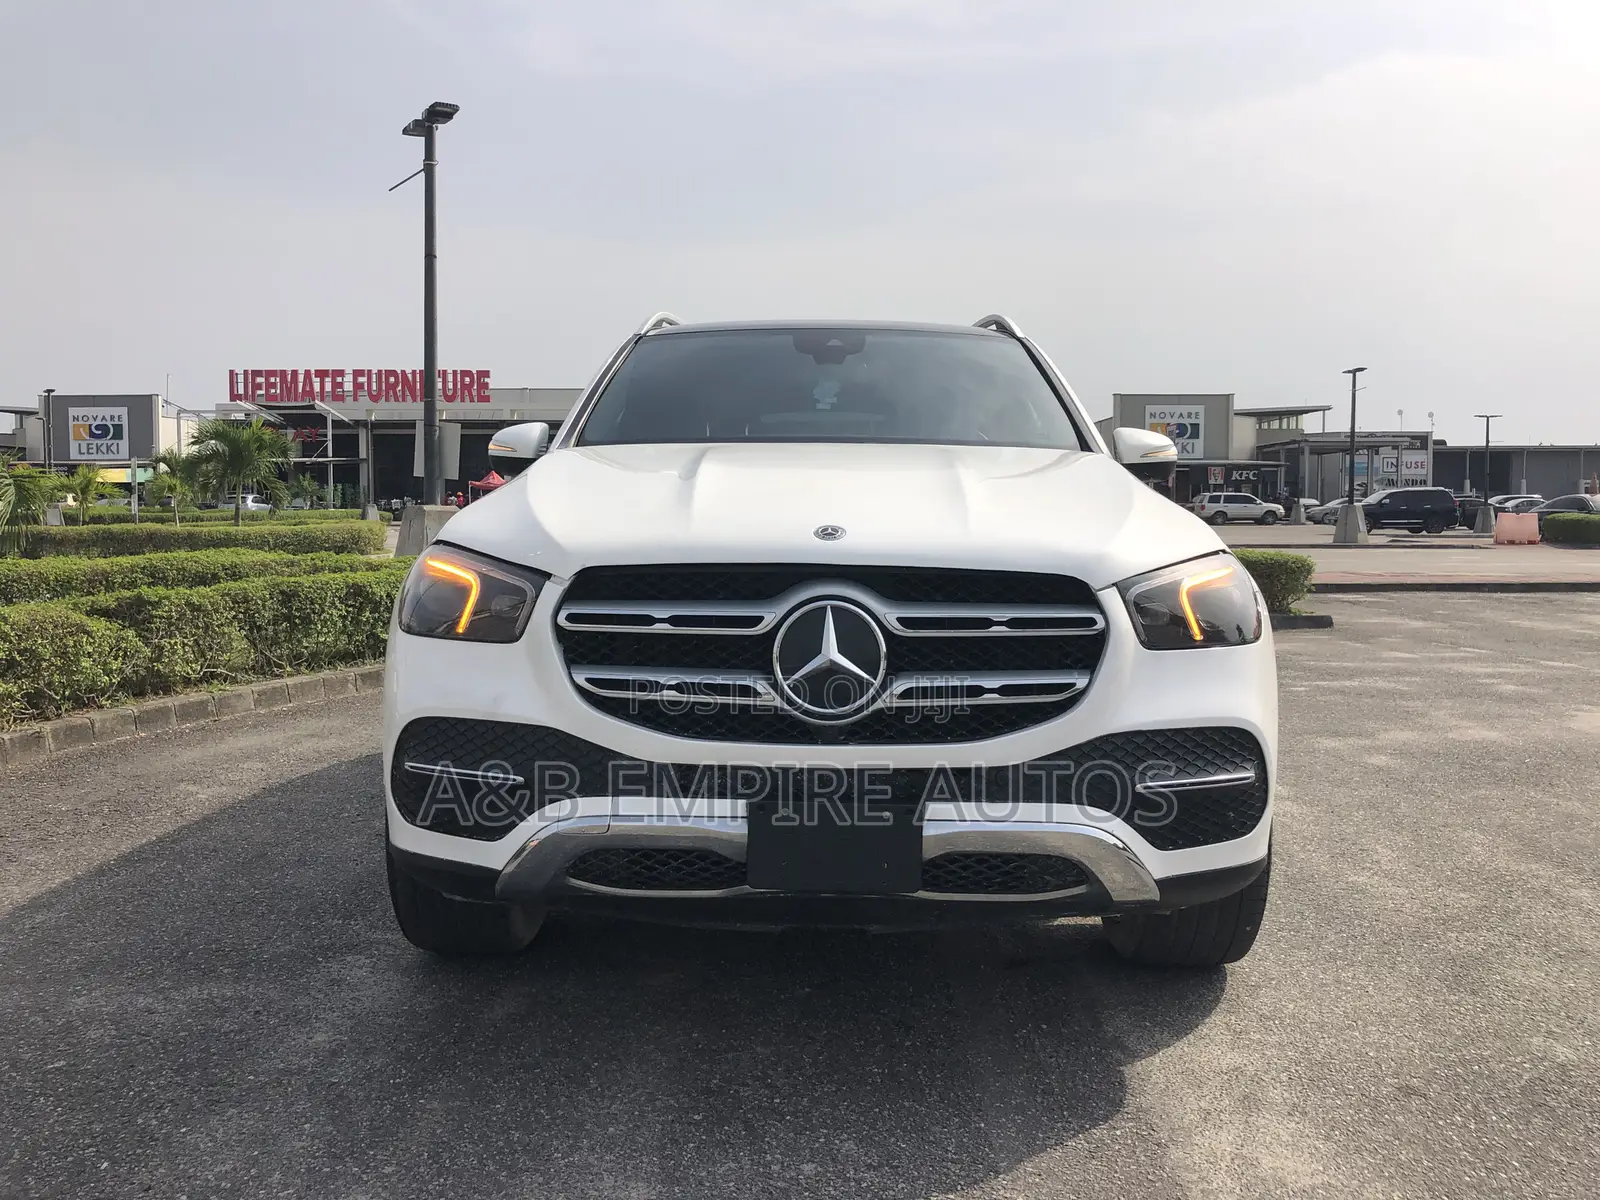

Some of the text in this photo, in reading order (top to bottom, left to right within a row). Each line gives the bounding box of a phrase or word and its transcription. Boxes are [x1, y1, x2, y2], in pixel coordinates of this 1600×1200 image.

[229, 369, 490, 402] LIFEMATE FURNIURE
[72, 414, 123, 422] NOVARE
[1149, 411, 1200, 420] NOVARE
[78, 442, 119, 455] LEKKI
[1386, 459, 1426, 470] INUSE
[1231, 470, 1259, 480] KFC
